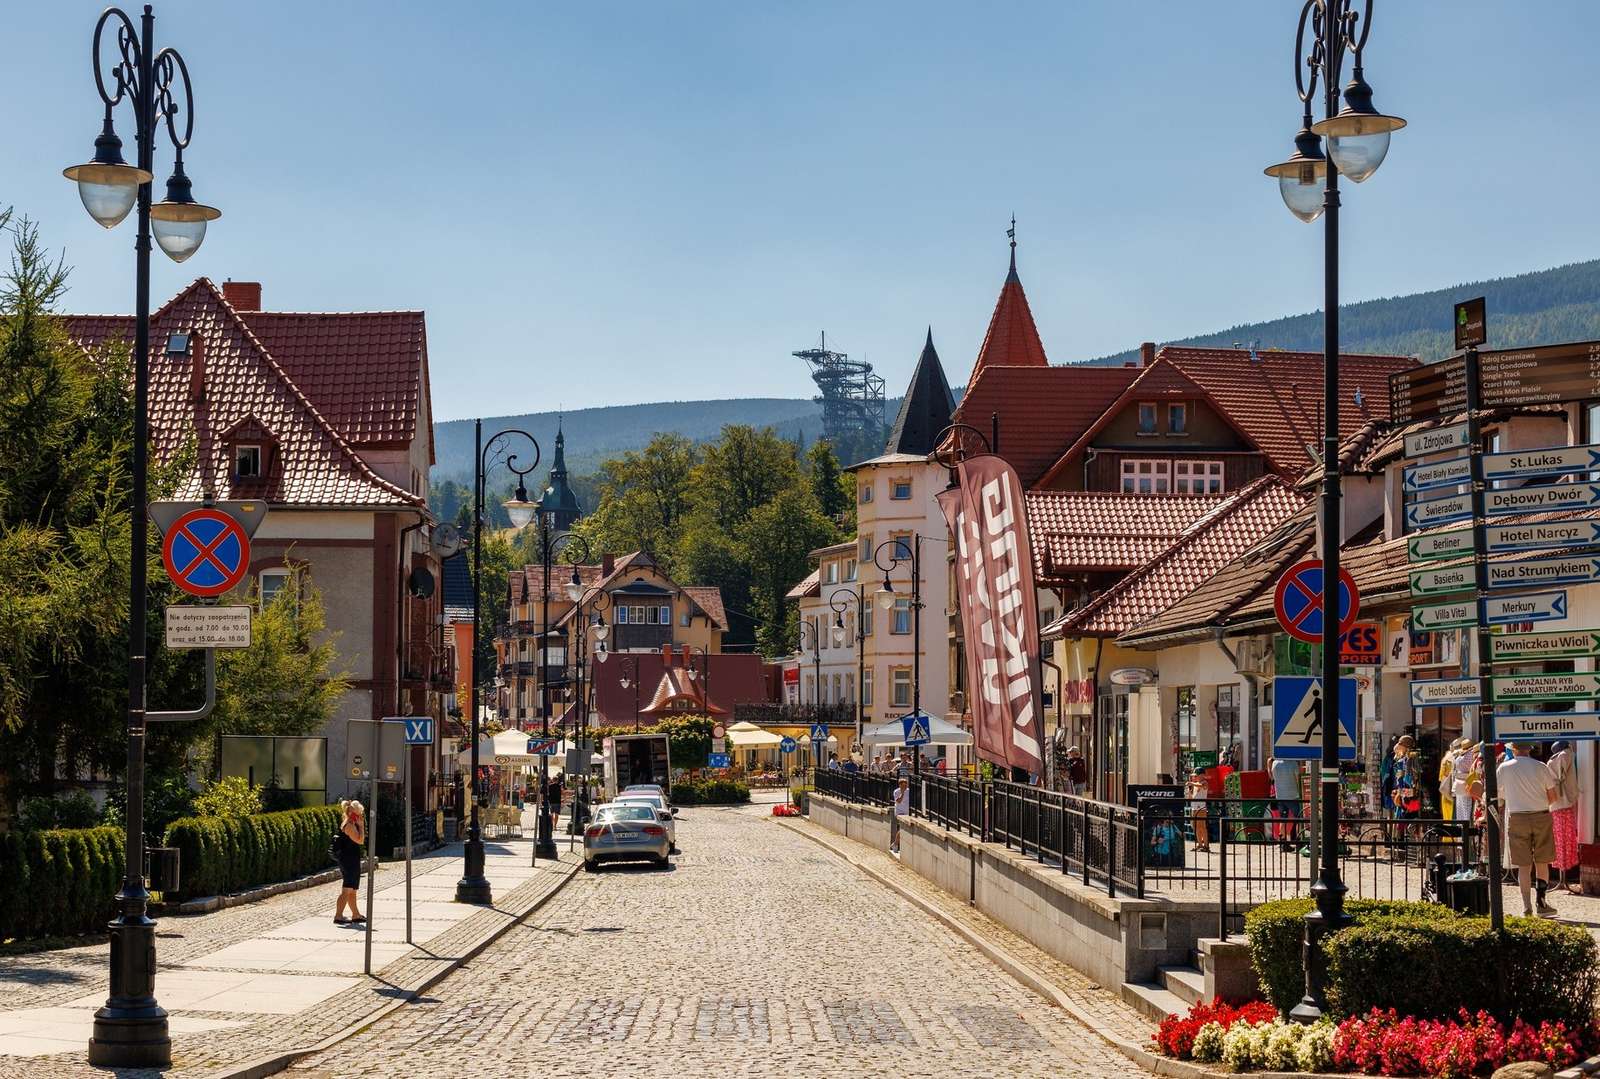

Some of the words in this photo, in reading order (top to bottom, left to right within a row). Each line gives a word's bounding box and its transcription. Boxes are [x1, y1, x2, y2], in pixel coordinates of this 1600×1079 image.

[1482, 355, 1499, 363] Zdrój
[1501, 353, 1535, 361] Czerniawa
[1500, 361, 1537, 369] Gondolowa
[1482, 372, 1502, 380] Single
[1504, 370, 1520, 378] Track
[1414, 439, 1422, 451] ul.
[1424, 433, 1454, 450] Zdrojowa
[1510, 458, 1526, 468] St.
[1528, 455, 1563, 467] Lukas
[1418, 472, 1432, 481] Hotel
[1434, 468, 1447, 479] Biały
[1448, 464, 1469, 475] Kamień
[1494, 494, 1544, 507] Dębowy
[1548, 488, 1582, 501] Dwór
[1426, 501, 1463, 516] Świeradów
[1500, 530, 1533, 542] Hotel
[1537, 528, 1578, 540] Narcyz
[1433, 538, 1460, 550] Berliner
[1492, 566, 1514, 578] Nad
[1518, 562, 1590, 577] Strumykiem
[1434, 572, 1464, 585] Basieńka
[1435, 609, 1450, 620] Villa
[1451, 606, 1467, 618] Vital
[1502, 600, 1536, 614] Merkury
[183, 614, 205, 622] dotyczy
[982, 471, 1042, 760] VIKING
[1392, 637, 1404, 660] 4F
[1496, 638, 1549, 650] Piwniczka
[1560, 635, 1589, 648] Wioli
[1340, 655, 1377, 663] PORT
[1558, 676, 1573, 684] RYB
[1428, 686, 1448, 696] Hotel
[1449, 684, 1476, 695] Sudetia
[1528, 686, 1558, 694] NATURY
[1564, 684, 1586, 692] MIÓD
[406, 721, 430, 740] XI
[1520, 718, 1574, 730] Turmalin
[528, 741, 555, 753] TAXI
[1136, 790, 1176, 798] VIKING
